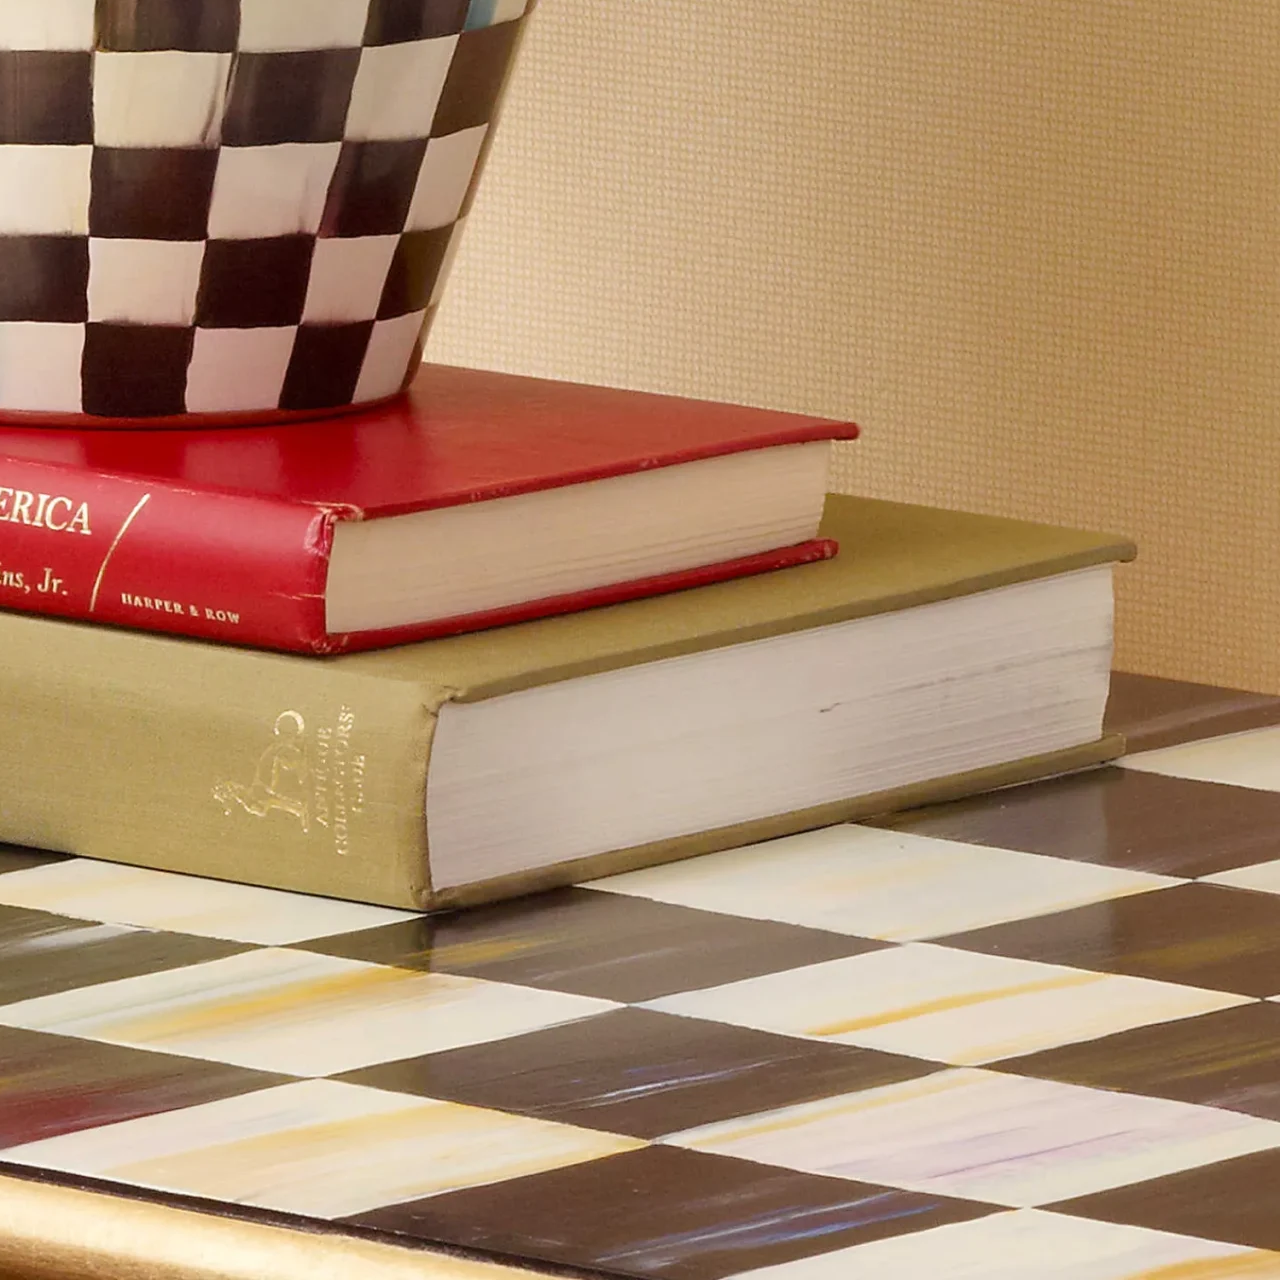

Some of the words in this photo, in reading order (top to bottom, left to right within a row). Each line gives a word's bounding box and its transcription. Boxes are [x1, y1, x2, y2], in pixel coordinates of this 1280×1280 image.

[37, 568, 68, 595] Jr.
[121, 593, 184, 614] HARPER
[189, 605, 199, 616] &
[205, 608, 239, 623] ROW
